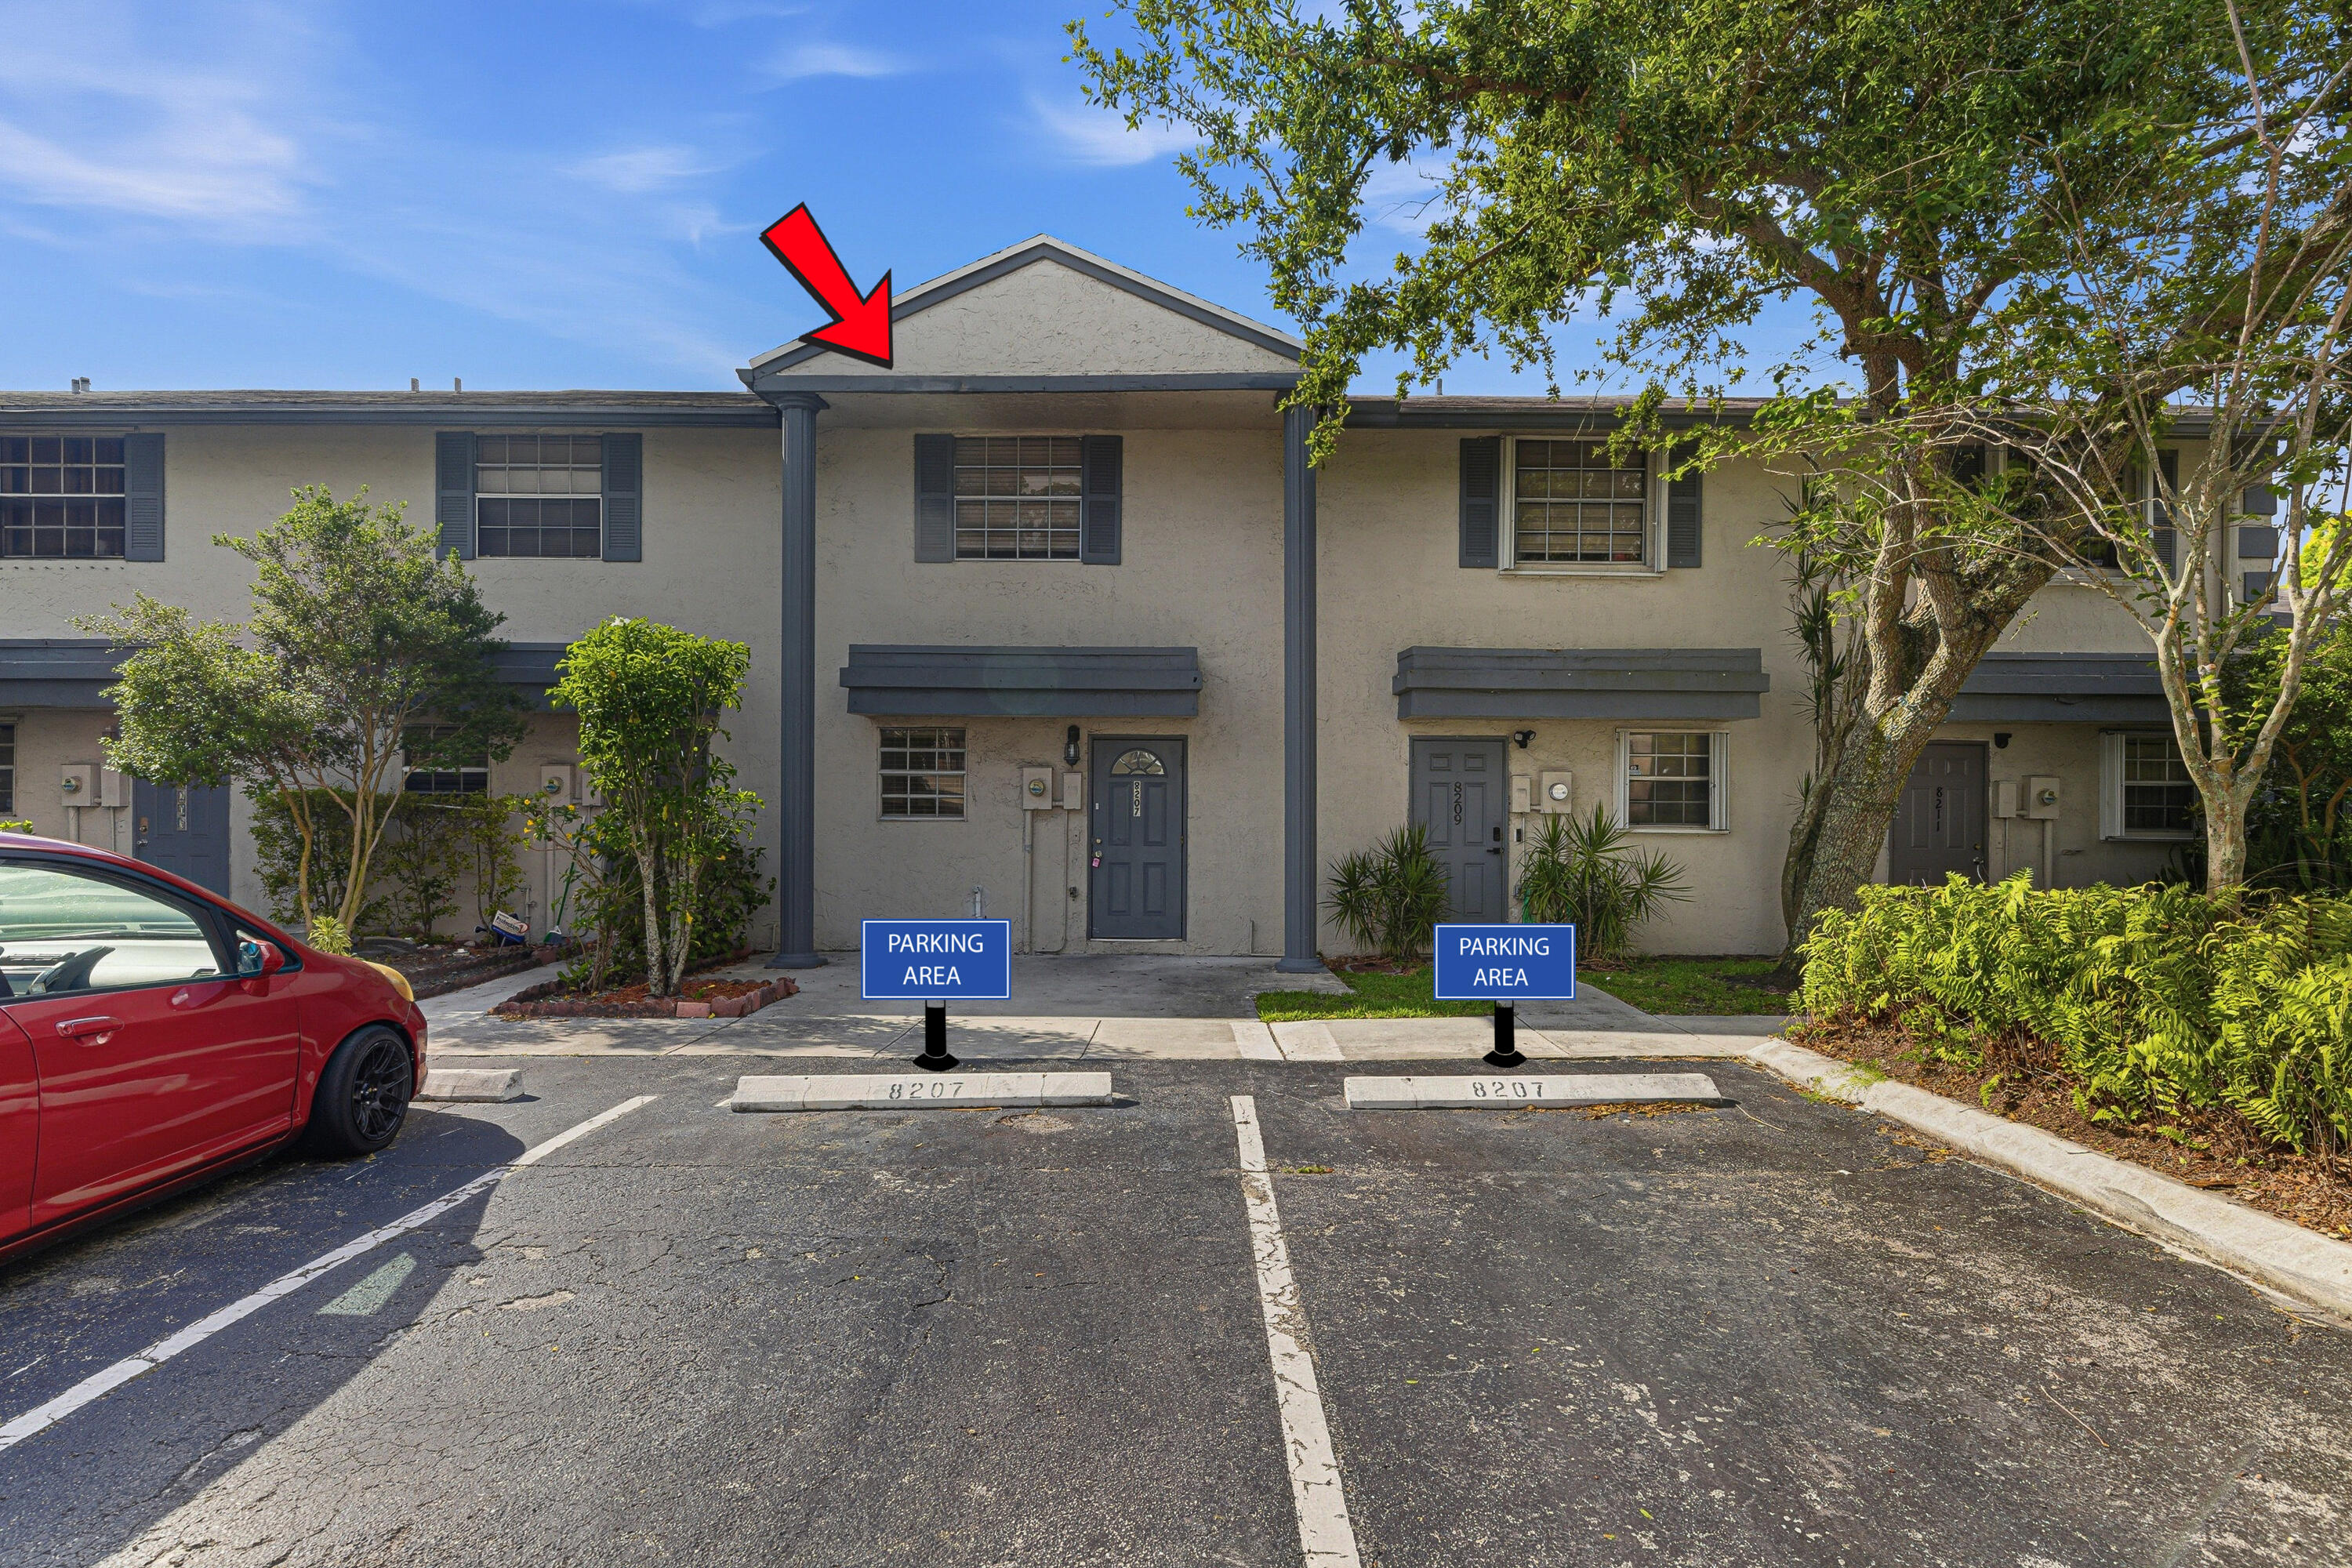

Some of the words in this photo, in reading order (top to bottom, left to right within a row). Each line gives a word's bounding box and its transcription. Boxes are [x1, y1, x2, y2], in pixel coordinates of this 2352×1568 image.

[1454, 781, 1462, 826] 8209
[1935, 786, 1944, 832] 8211
[888, 1082, 964, 1099] 8207
[1472, 1081, 1544, 1098] 8207
